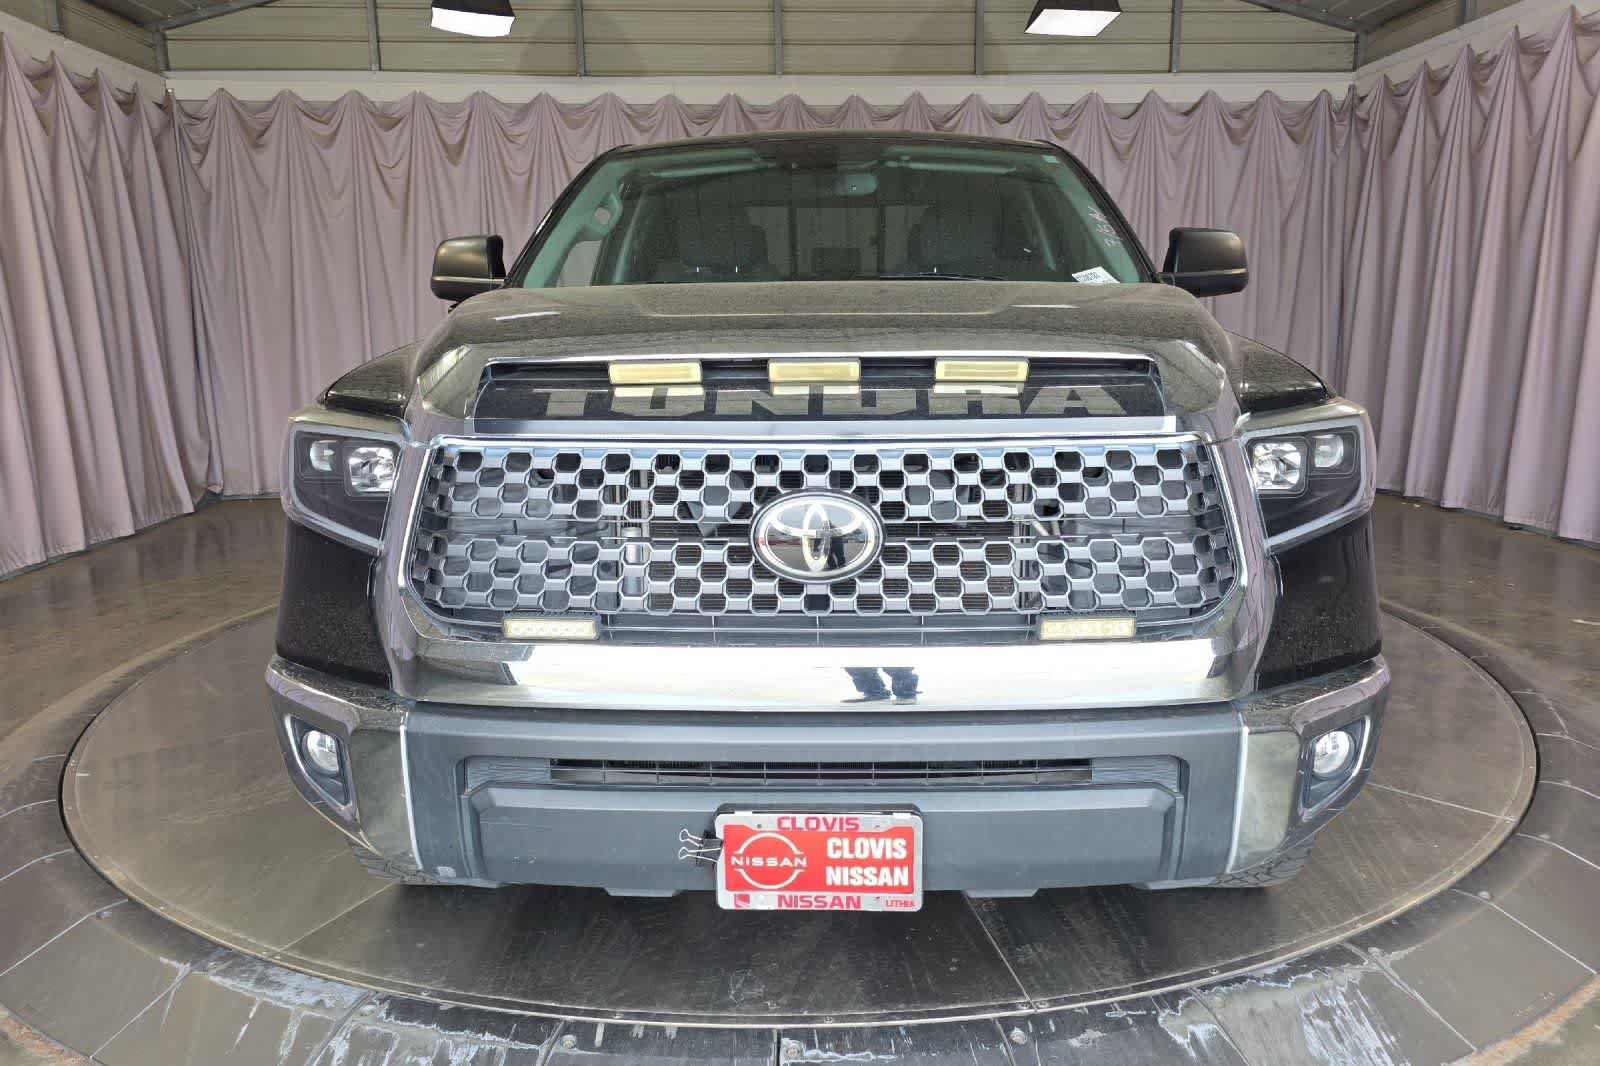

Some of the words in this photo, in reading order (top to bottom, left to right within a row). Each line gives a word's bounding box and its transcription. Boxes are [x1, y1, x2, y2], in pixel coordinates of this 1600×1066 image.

[531, 386, 1127, 416] TUNDRA
[777, 816, 860, 831] CLOVIS
[827, 838, 907, 860] CLOVIS
[731, 856, 807, 867] NISSAN
[825, 866, 909, 886] NISSAN
[778, 895, 860, 910] NISSAN
